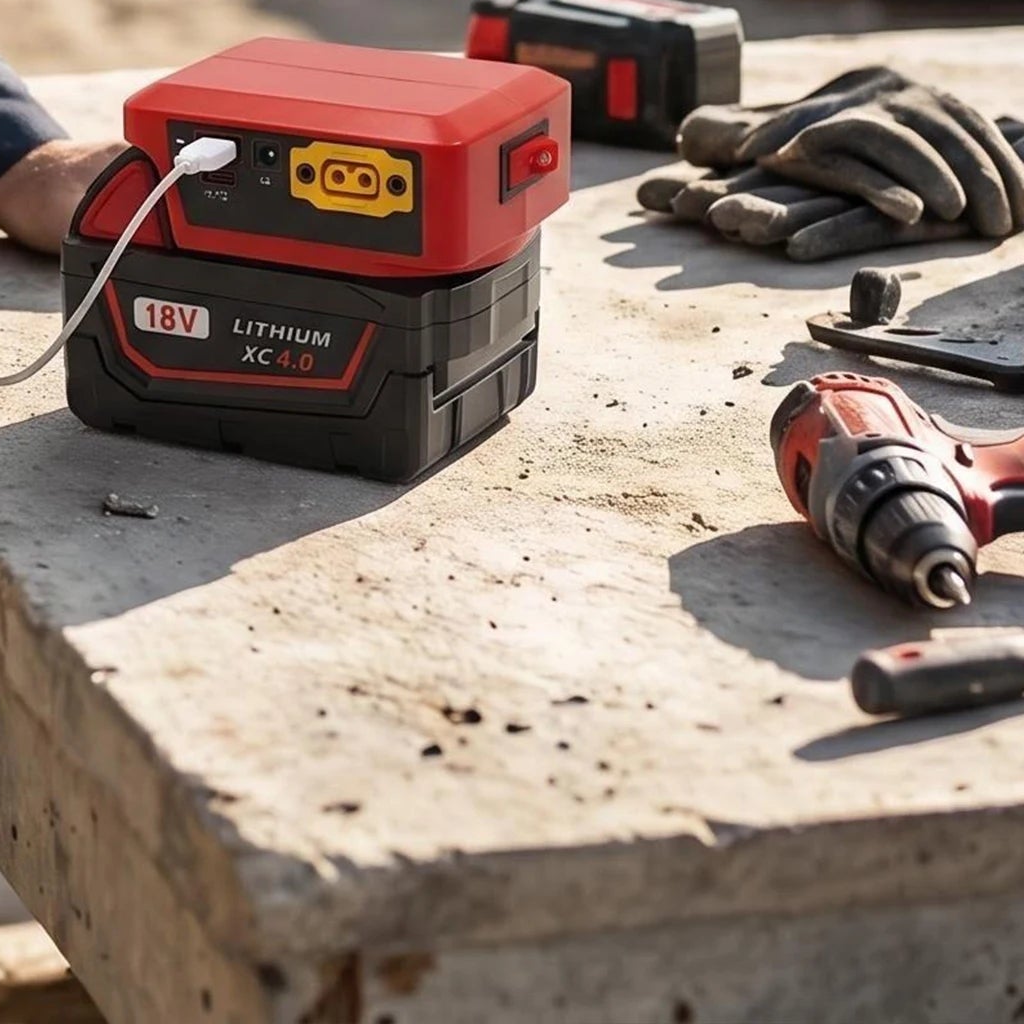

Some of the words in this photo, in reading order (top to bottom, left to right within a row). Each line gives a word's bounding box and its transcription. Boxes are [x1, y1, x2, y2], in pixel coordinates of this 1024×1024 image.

[145, 302, 198, 334] 18V
[232, 318, 332, 348] LITHIUM
[241, 345, 274, 365] XC
[276, 349, 314, 372] 4.0
